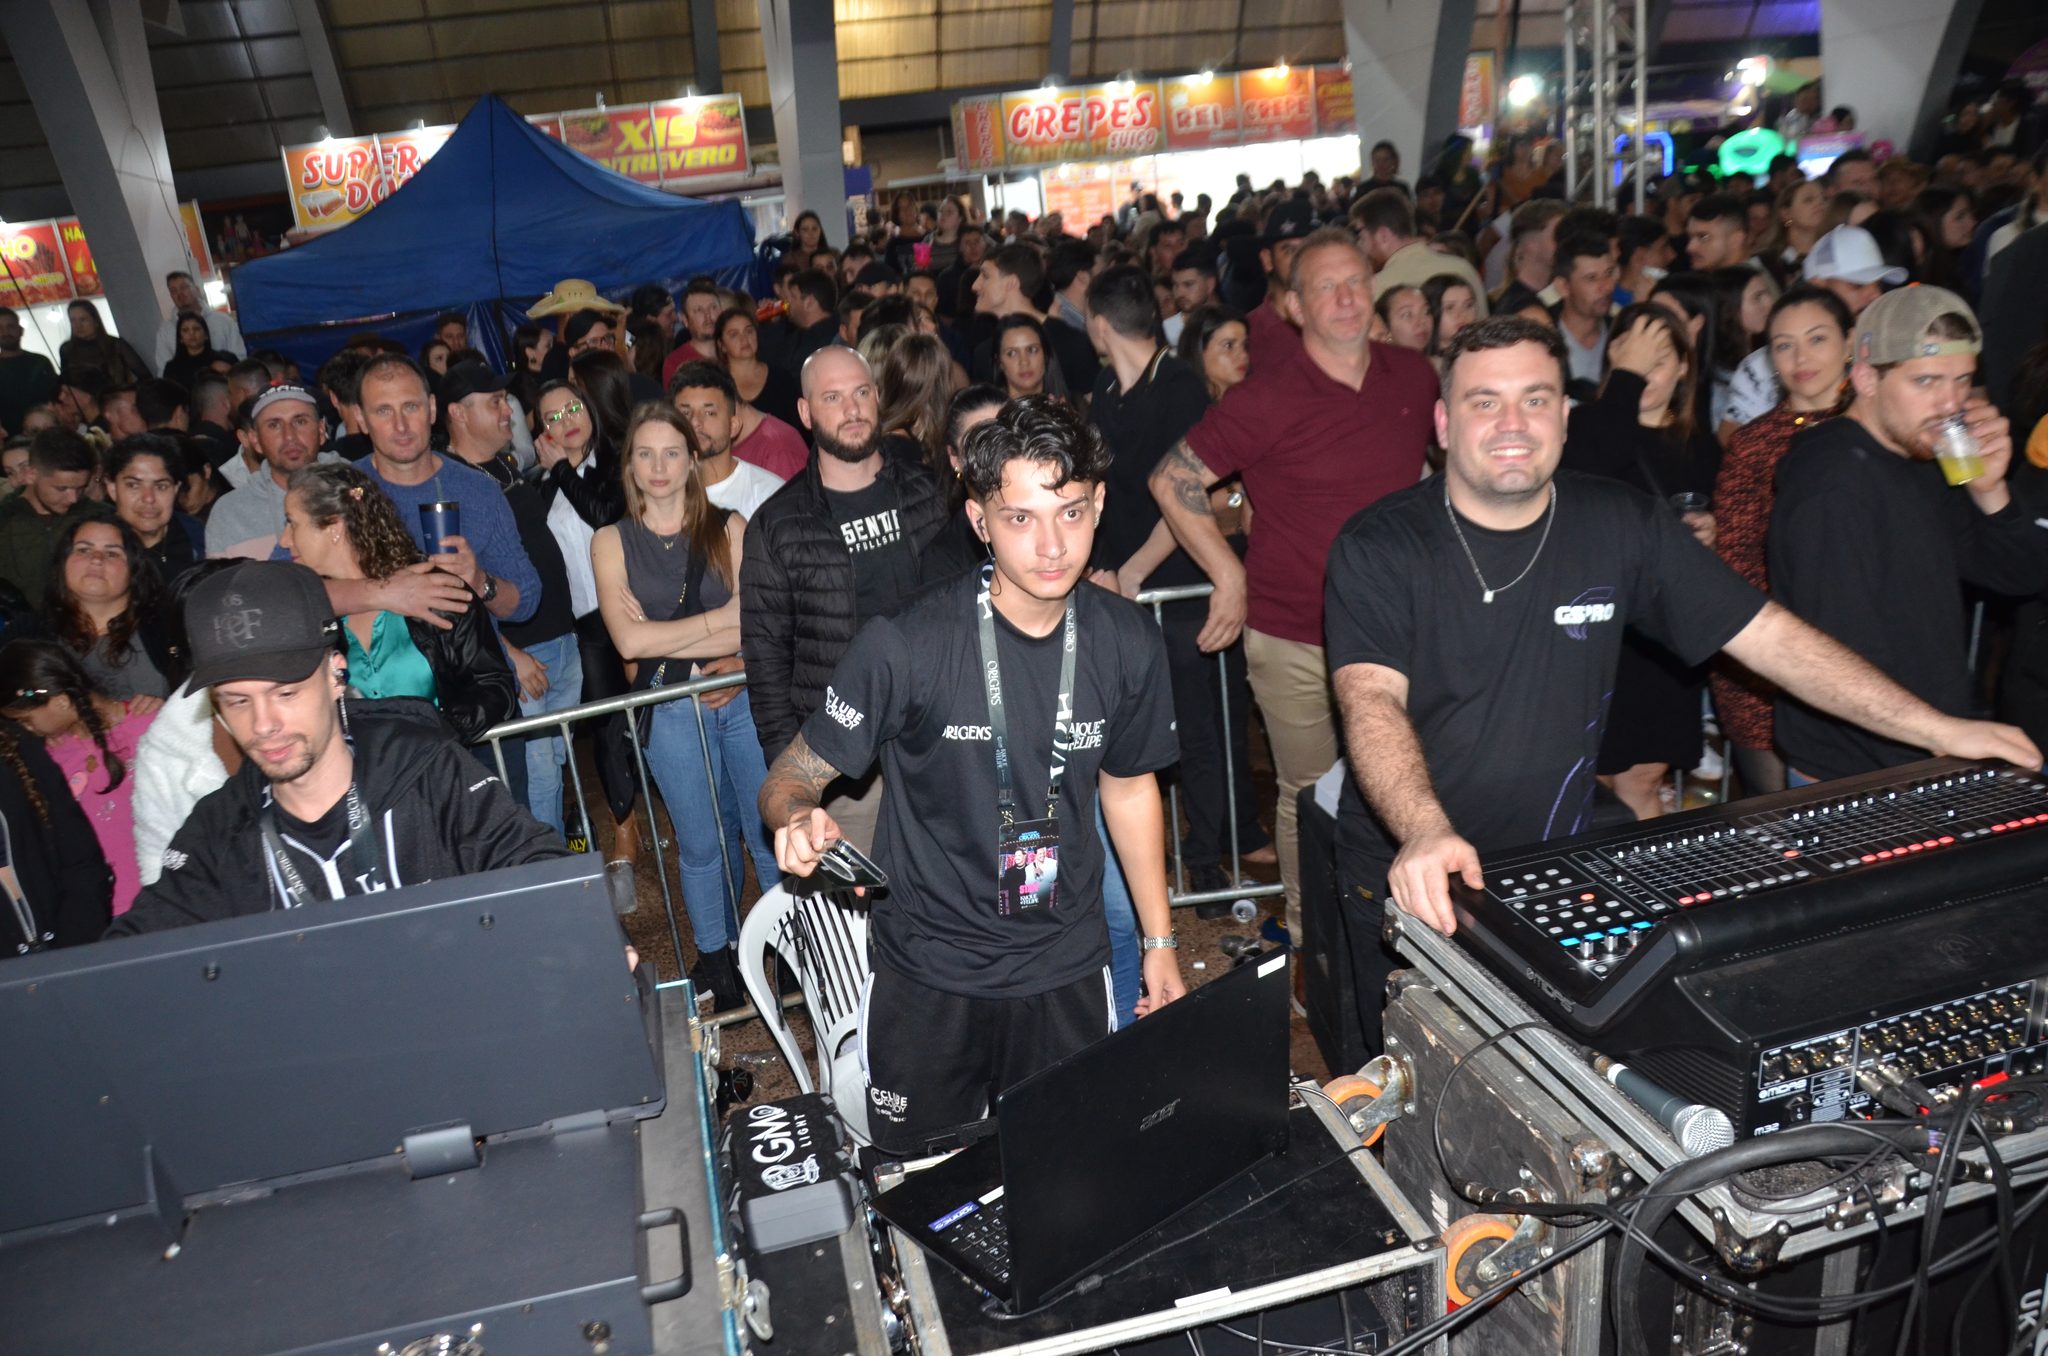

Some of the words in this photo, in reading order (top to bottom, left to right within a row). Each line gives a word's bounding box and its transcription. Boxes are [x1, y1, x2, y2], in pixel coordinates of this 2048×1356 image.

[615, 113, 699, 153] XIS
[1009, 92, 1153, 143] CREPES
[1173, 102, 1222, 135] REI
[303, 142, 421, 189] SUPER
[346, 171, 418, 214] DO
[63, 225, 86, 243] HA
[1065, 607, 1075, 652] ORIGENS
[986, 660, 1002, 706] ORIGENS
[825, 704, 861, 730] OWBOY
[942, 725, 992, 741] RIGENS
[1068, 720, 1102, 737] AIQUE
[793, 1114, 813, 1148] LIGHT
[1754, 1122, 1780, 1136] M32
